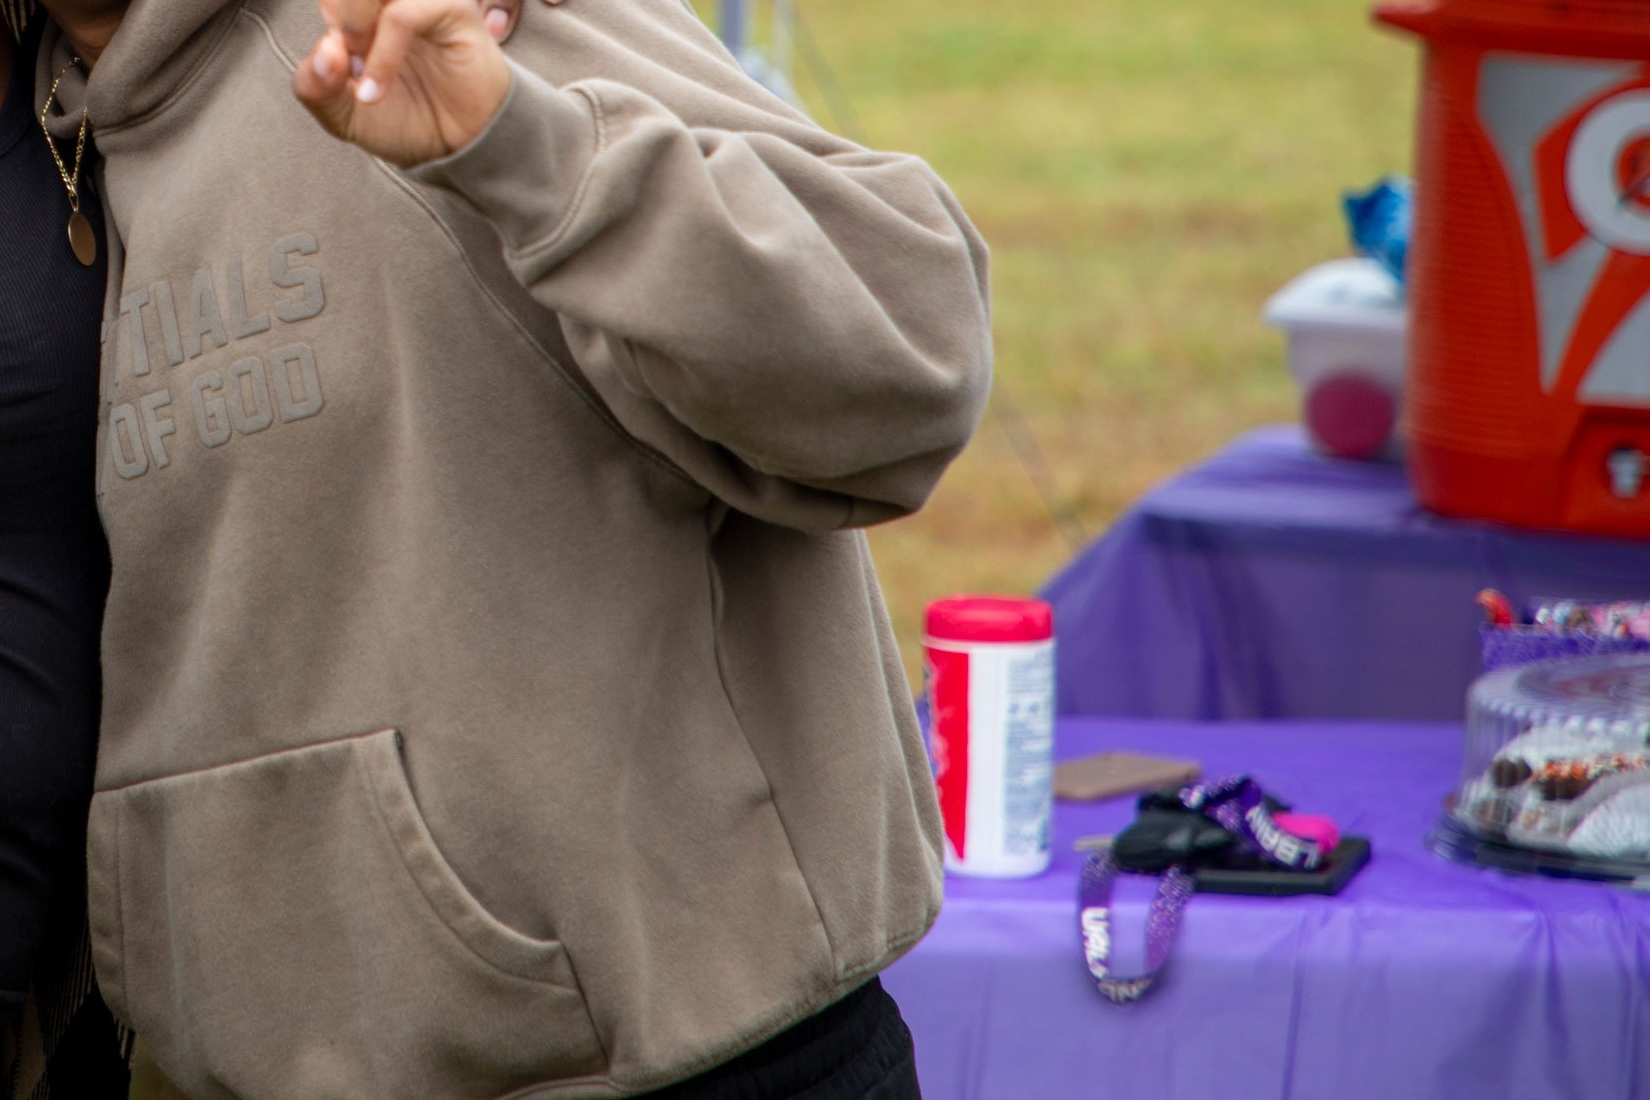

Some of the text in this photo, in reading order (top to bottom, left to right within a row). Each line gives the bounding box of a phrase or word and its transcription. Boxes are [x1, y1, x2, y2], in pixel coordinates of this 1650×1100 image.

[101, 232, 326, 378] TIALS
[108, 342, 325, 480] OF GOD
